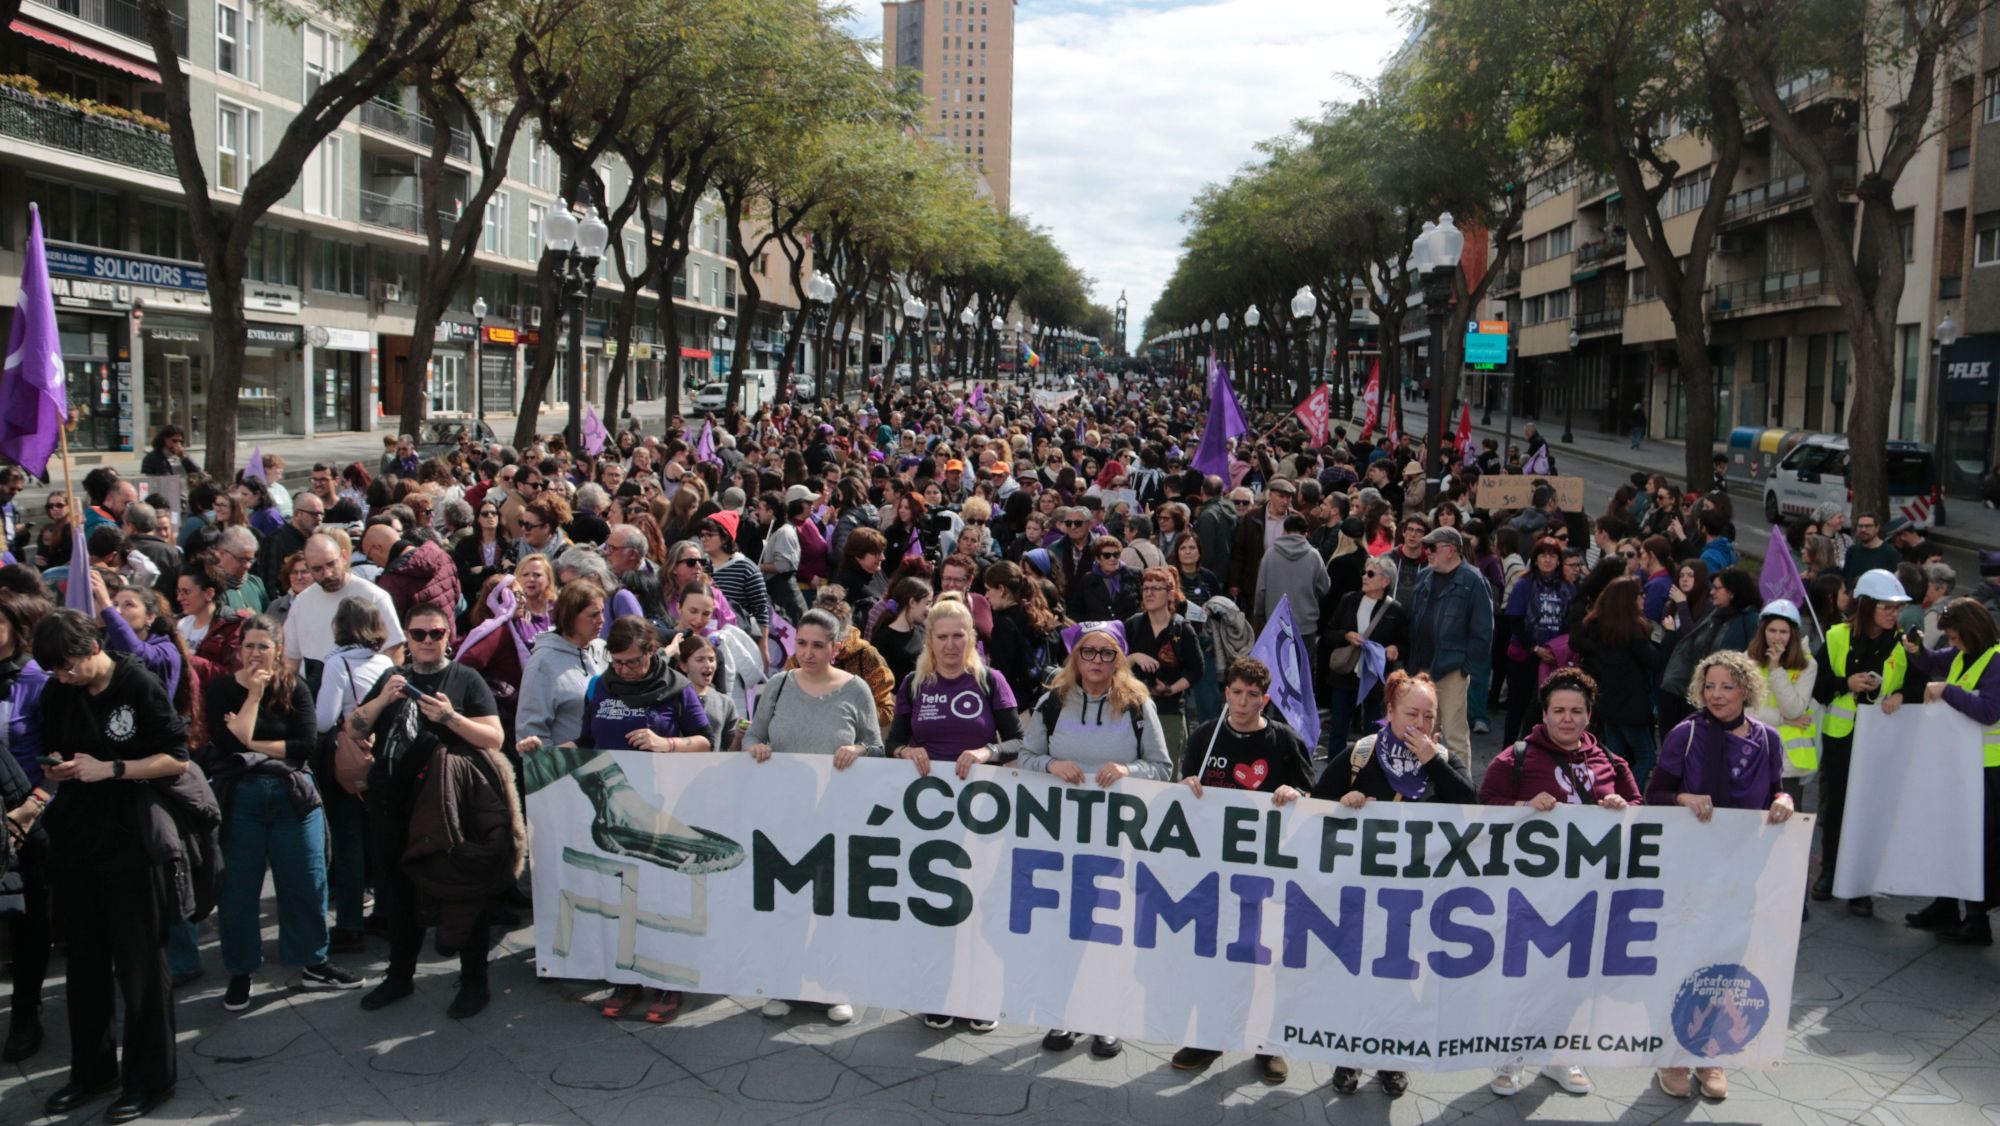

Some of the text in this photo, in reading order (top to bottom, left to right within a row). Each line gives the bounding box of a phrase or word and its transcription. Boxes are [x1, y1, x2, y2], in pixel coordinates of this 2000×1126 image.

[94, 256, 182, 286] SOLICITORS
[1468, 321, 1477, 333] P
[921, 693, 948, 703] Teta
[1207, 756, 1228, 769] no
[904, 775, 1663, 878] CONTRA EL FEIXISME
[752, 804, 1665, 980] MÉS FEMINISME
[1685, 973, 1751, 989] Plataforma
[1692, 986, 1748, 999] Feminista
[1732, 996, 1765, 1009] Camp
[1284, 1025, 1664, 1058] PLATAFORMA FEMINISTA DEL CAMP
